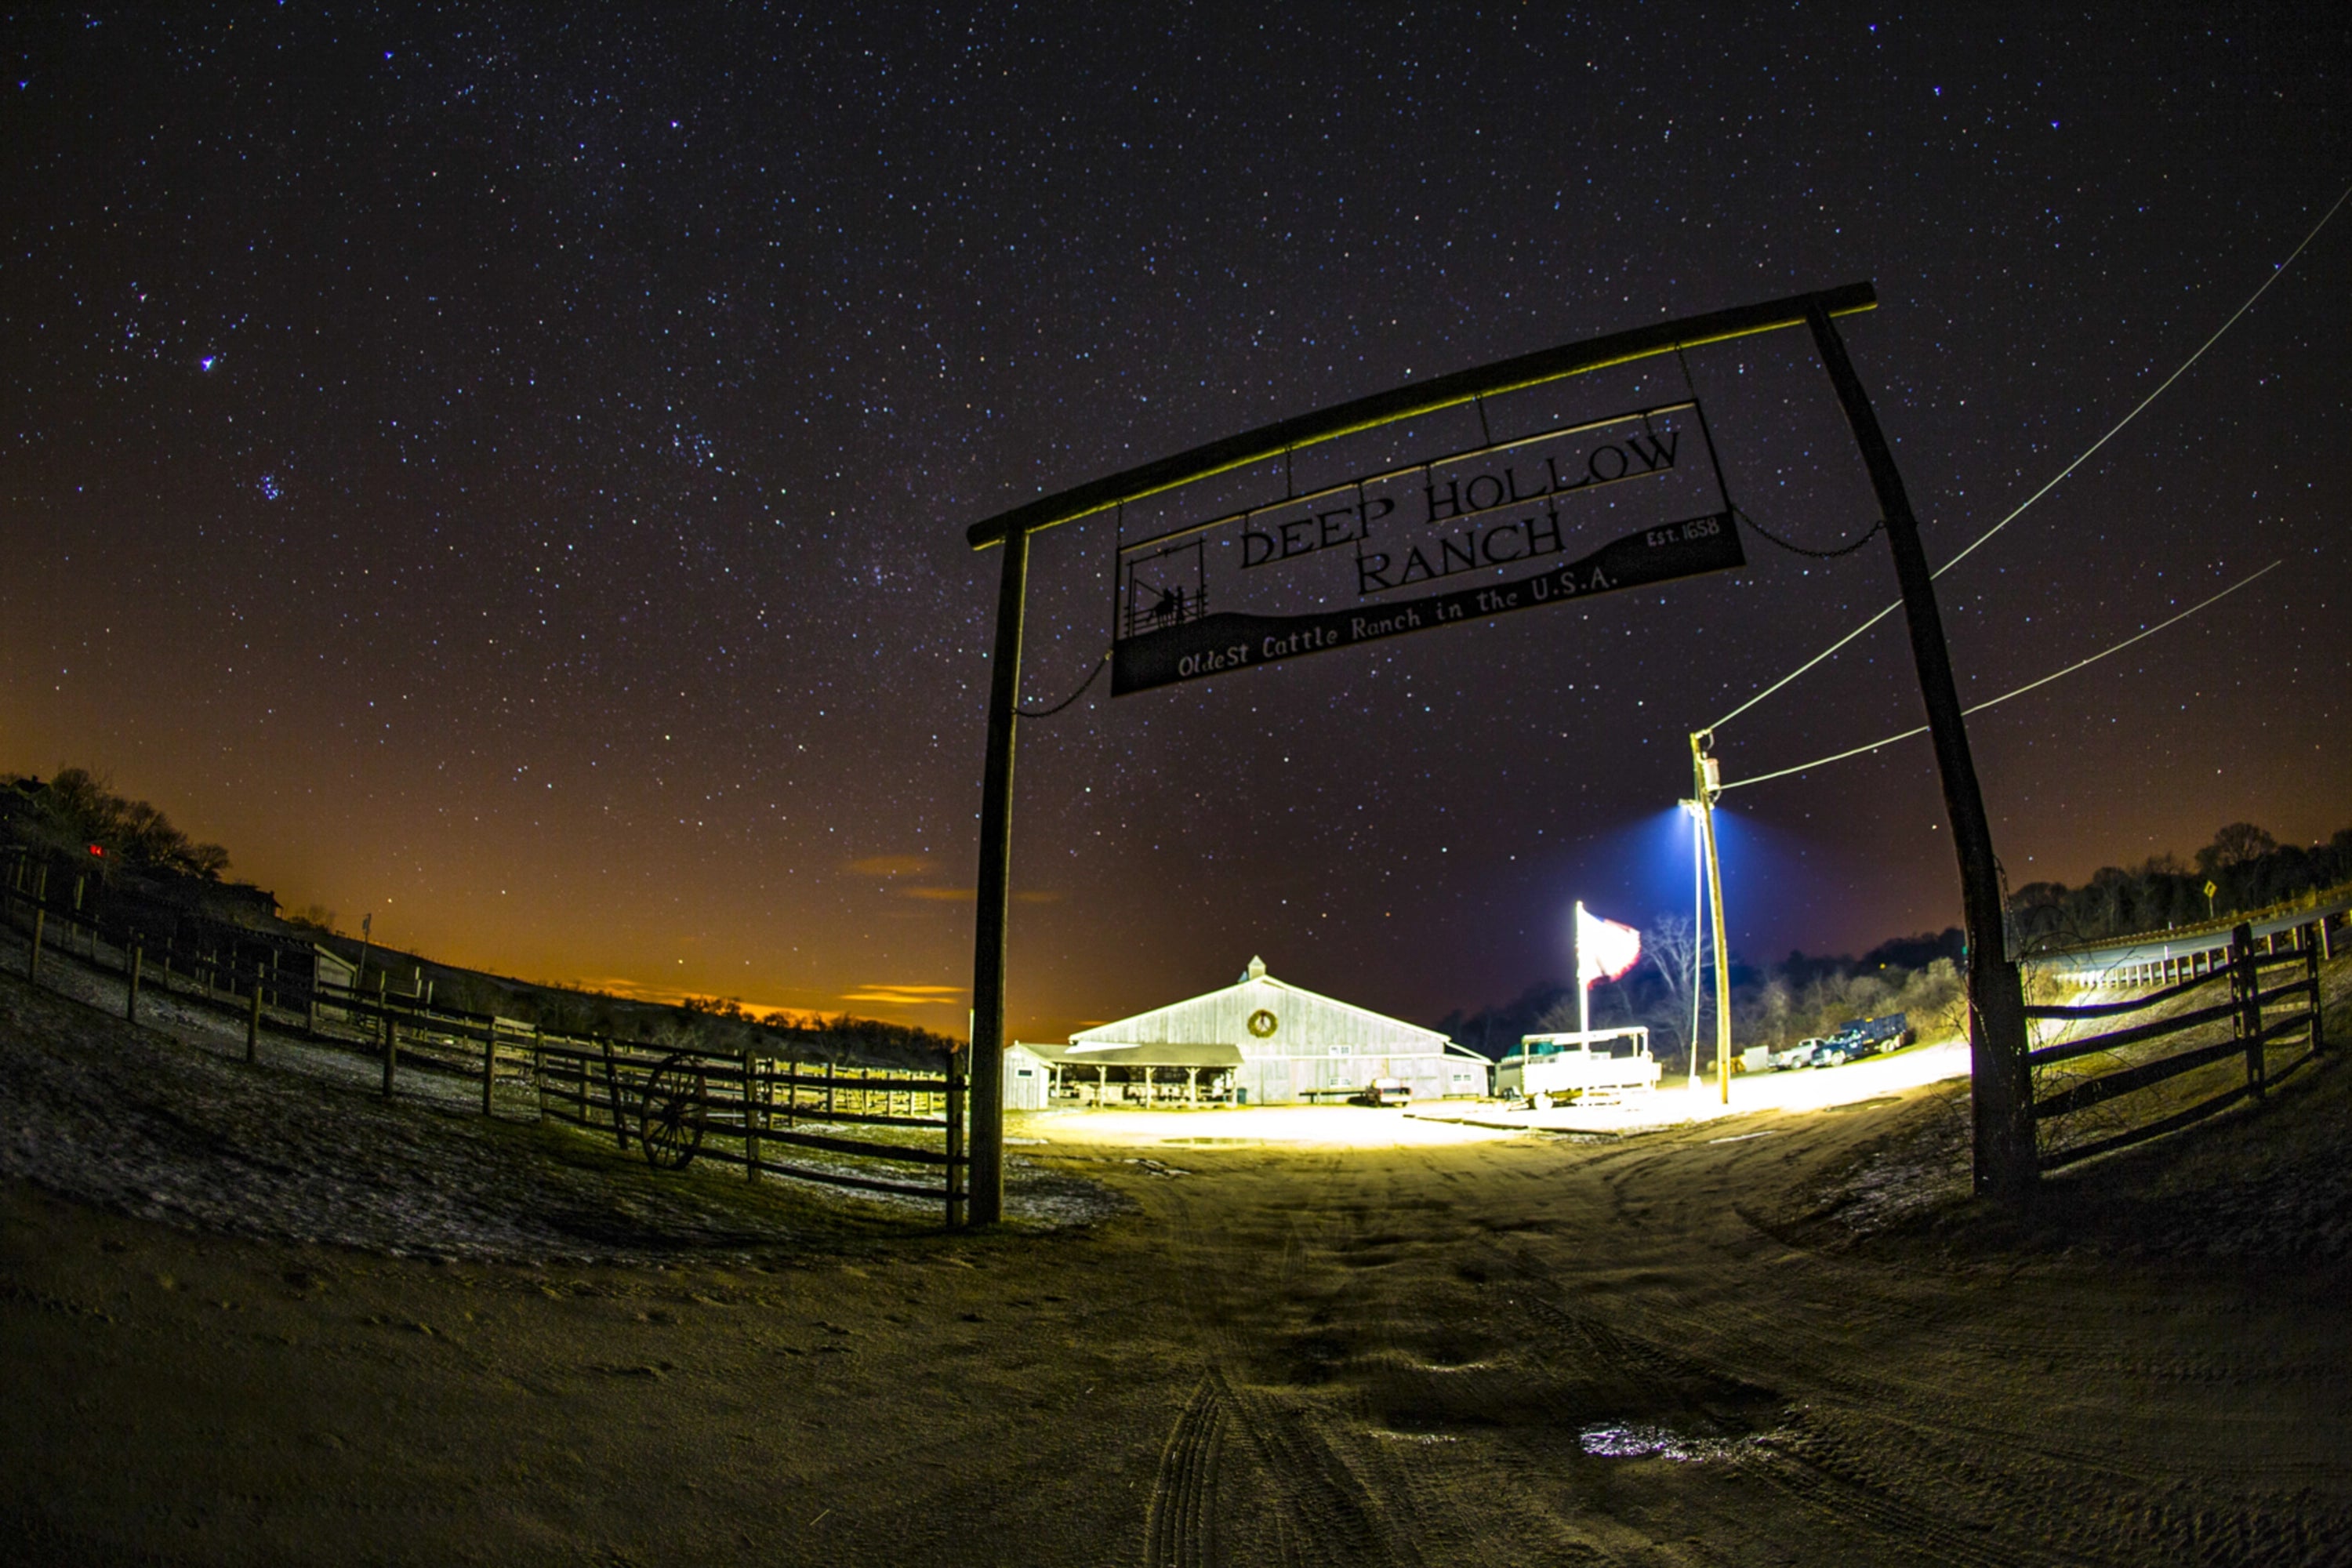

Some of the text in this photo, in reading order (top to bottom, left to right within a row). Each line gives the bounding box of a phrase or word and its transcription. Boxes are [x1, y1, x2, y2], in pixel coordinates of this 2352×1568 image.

[1240, 432, 1680, 568] DEEP HOLLOW
[1682, 517, 1720, 540] 1658
[1356, 512, 1566, 595] RANCH
[1262, 627, 1338, 658] Cattle
[1352, 608, 1421, 640] Ranch
[1437, 601, 1463, 620] in
[1477, 591, 1518, 612] the
[1532, 566, 1617, 601] U.S.A.
